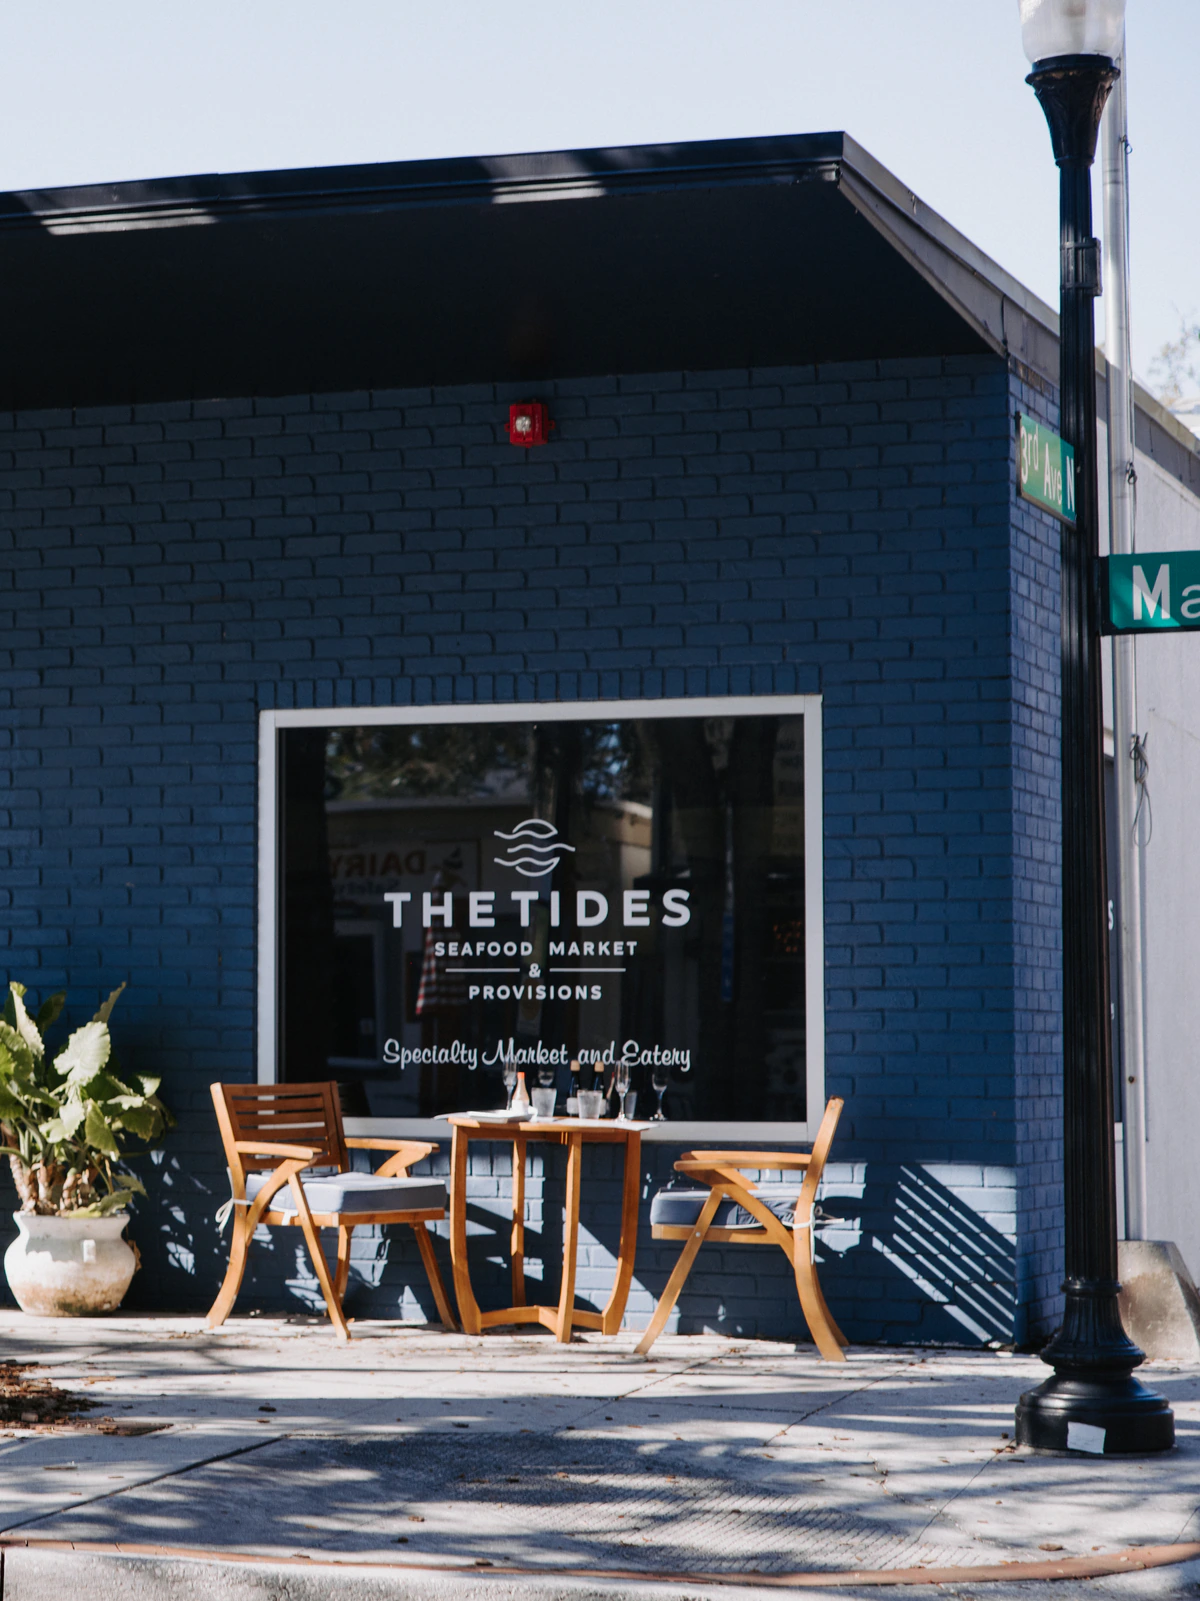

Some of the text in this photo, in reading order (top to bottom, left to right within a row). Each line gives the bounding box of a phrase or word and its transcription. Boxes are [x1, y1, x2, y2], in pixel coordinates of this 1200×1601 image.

[1020, 424, 1075, 512] 3rd Ave N
[434, 941, 638, 957] SEAFOOD MARKET
[528, 962, 541, 978] &
[469, 985, 602, 1000] PROVISIONS
[382, 1037, 692, 1072] Specialty Market and Eatery
